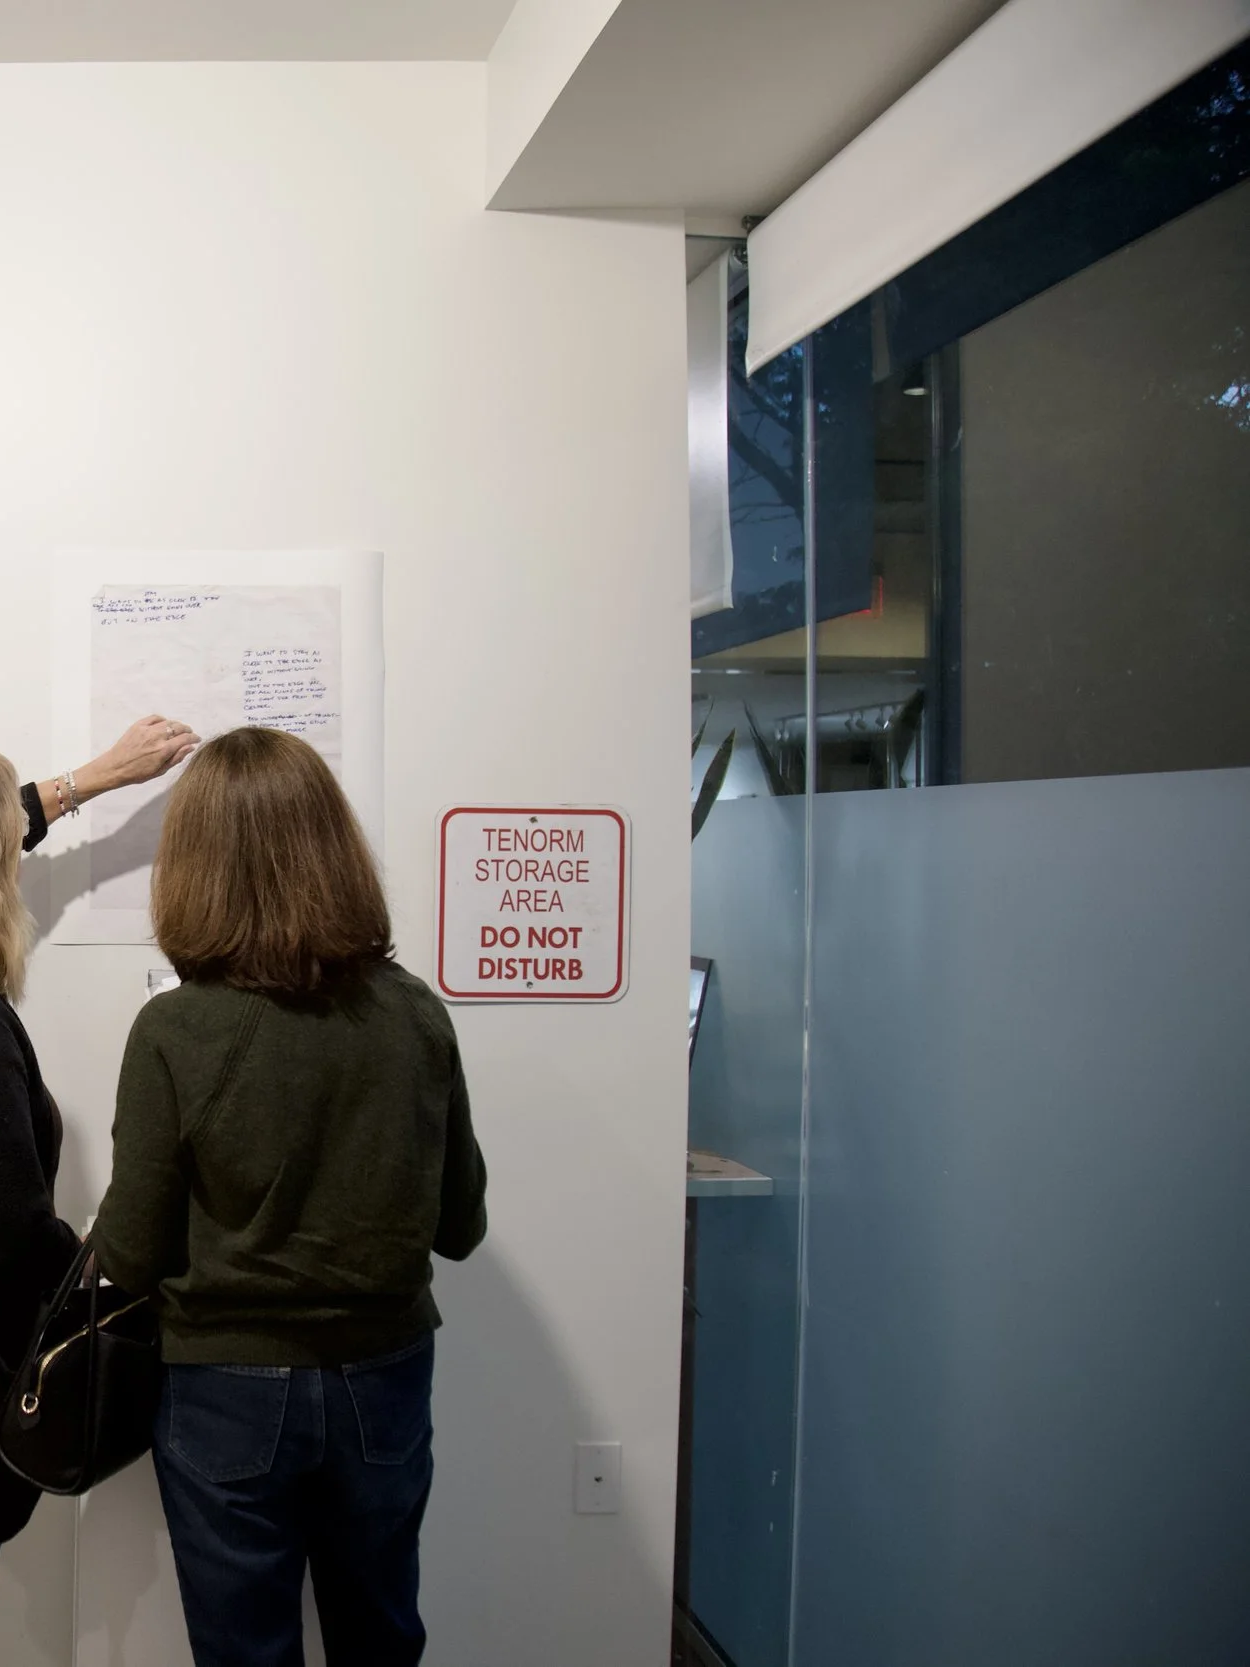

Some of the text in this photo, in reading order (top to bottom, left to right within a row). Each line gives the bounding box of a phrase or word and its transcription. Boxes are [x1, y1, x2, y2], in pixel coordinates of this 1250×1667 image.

[482, 828, 584, 853] TENORM
[475, 858, 590, 883] STORAGE
[499, 889, 564, 913] AREA
[480, 926, 583, 949] DO NOT
[478, 957, 584, 981] DISTURB
